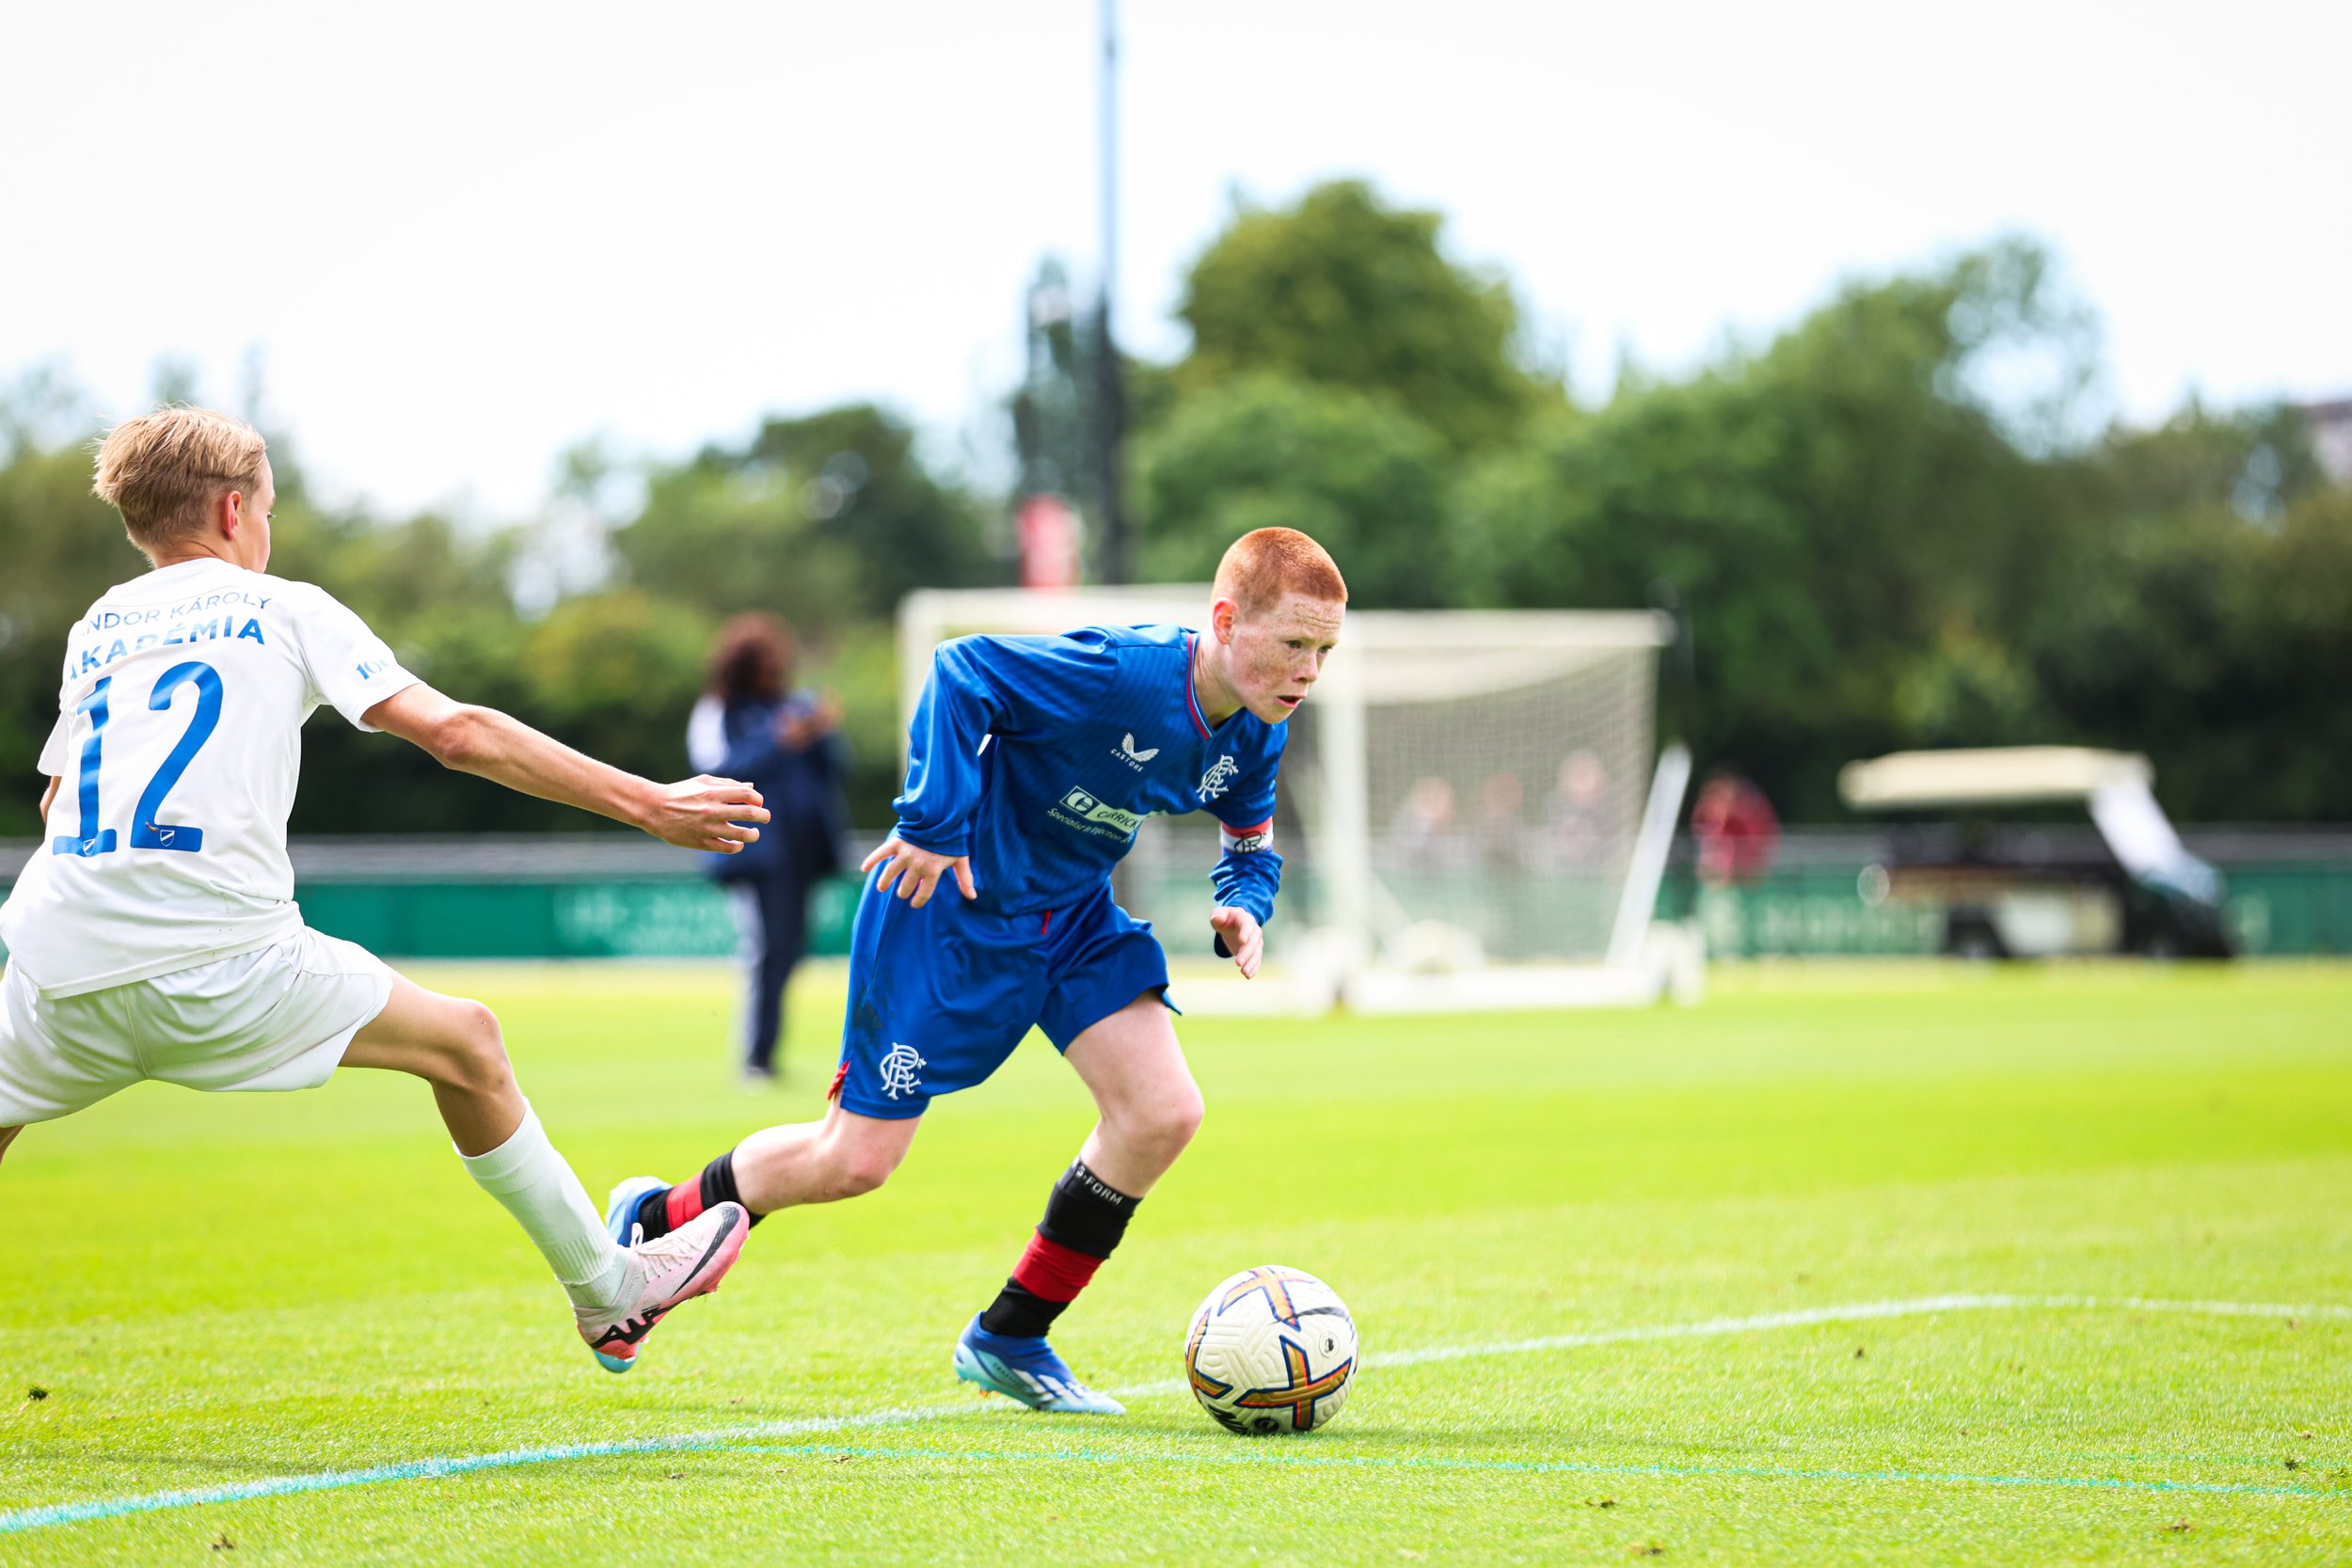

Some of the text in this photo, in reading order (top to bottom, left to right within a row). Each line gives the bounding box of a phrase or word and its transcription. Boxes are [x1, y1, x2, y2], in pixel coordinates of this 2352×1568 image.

[170, 592, 272, 620] KÁROLY
[53, 661, 223, 858] 12
[1111, 748, 1143, 771] CASTORE
